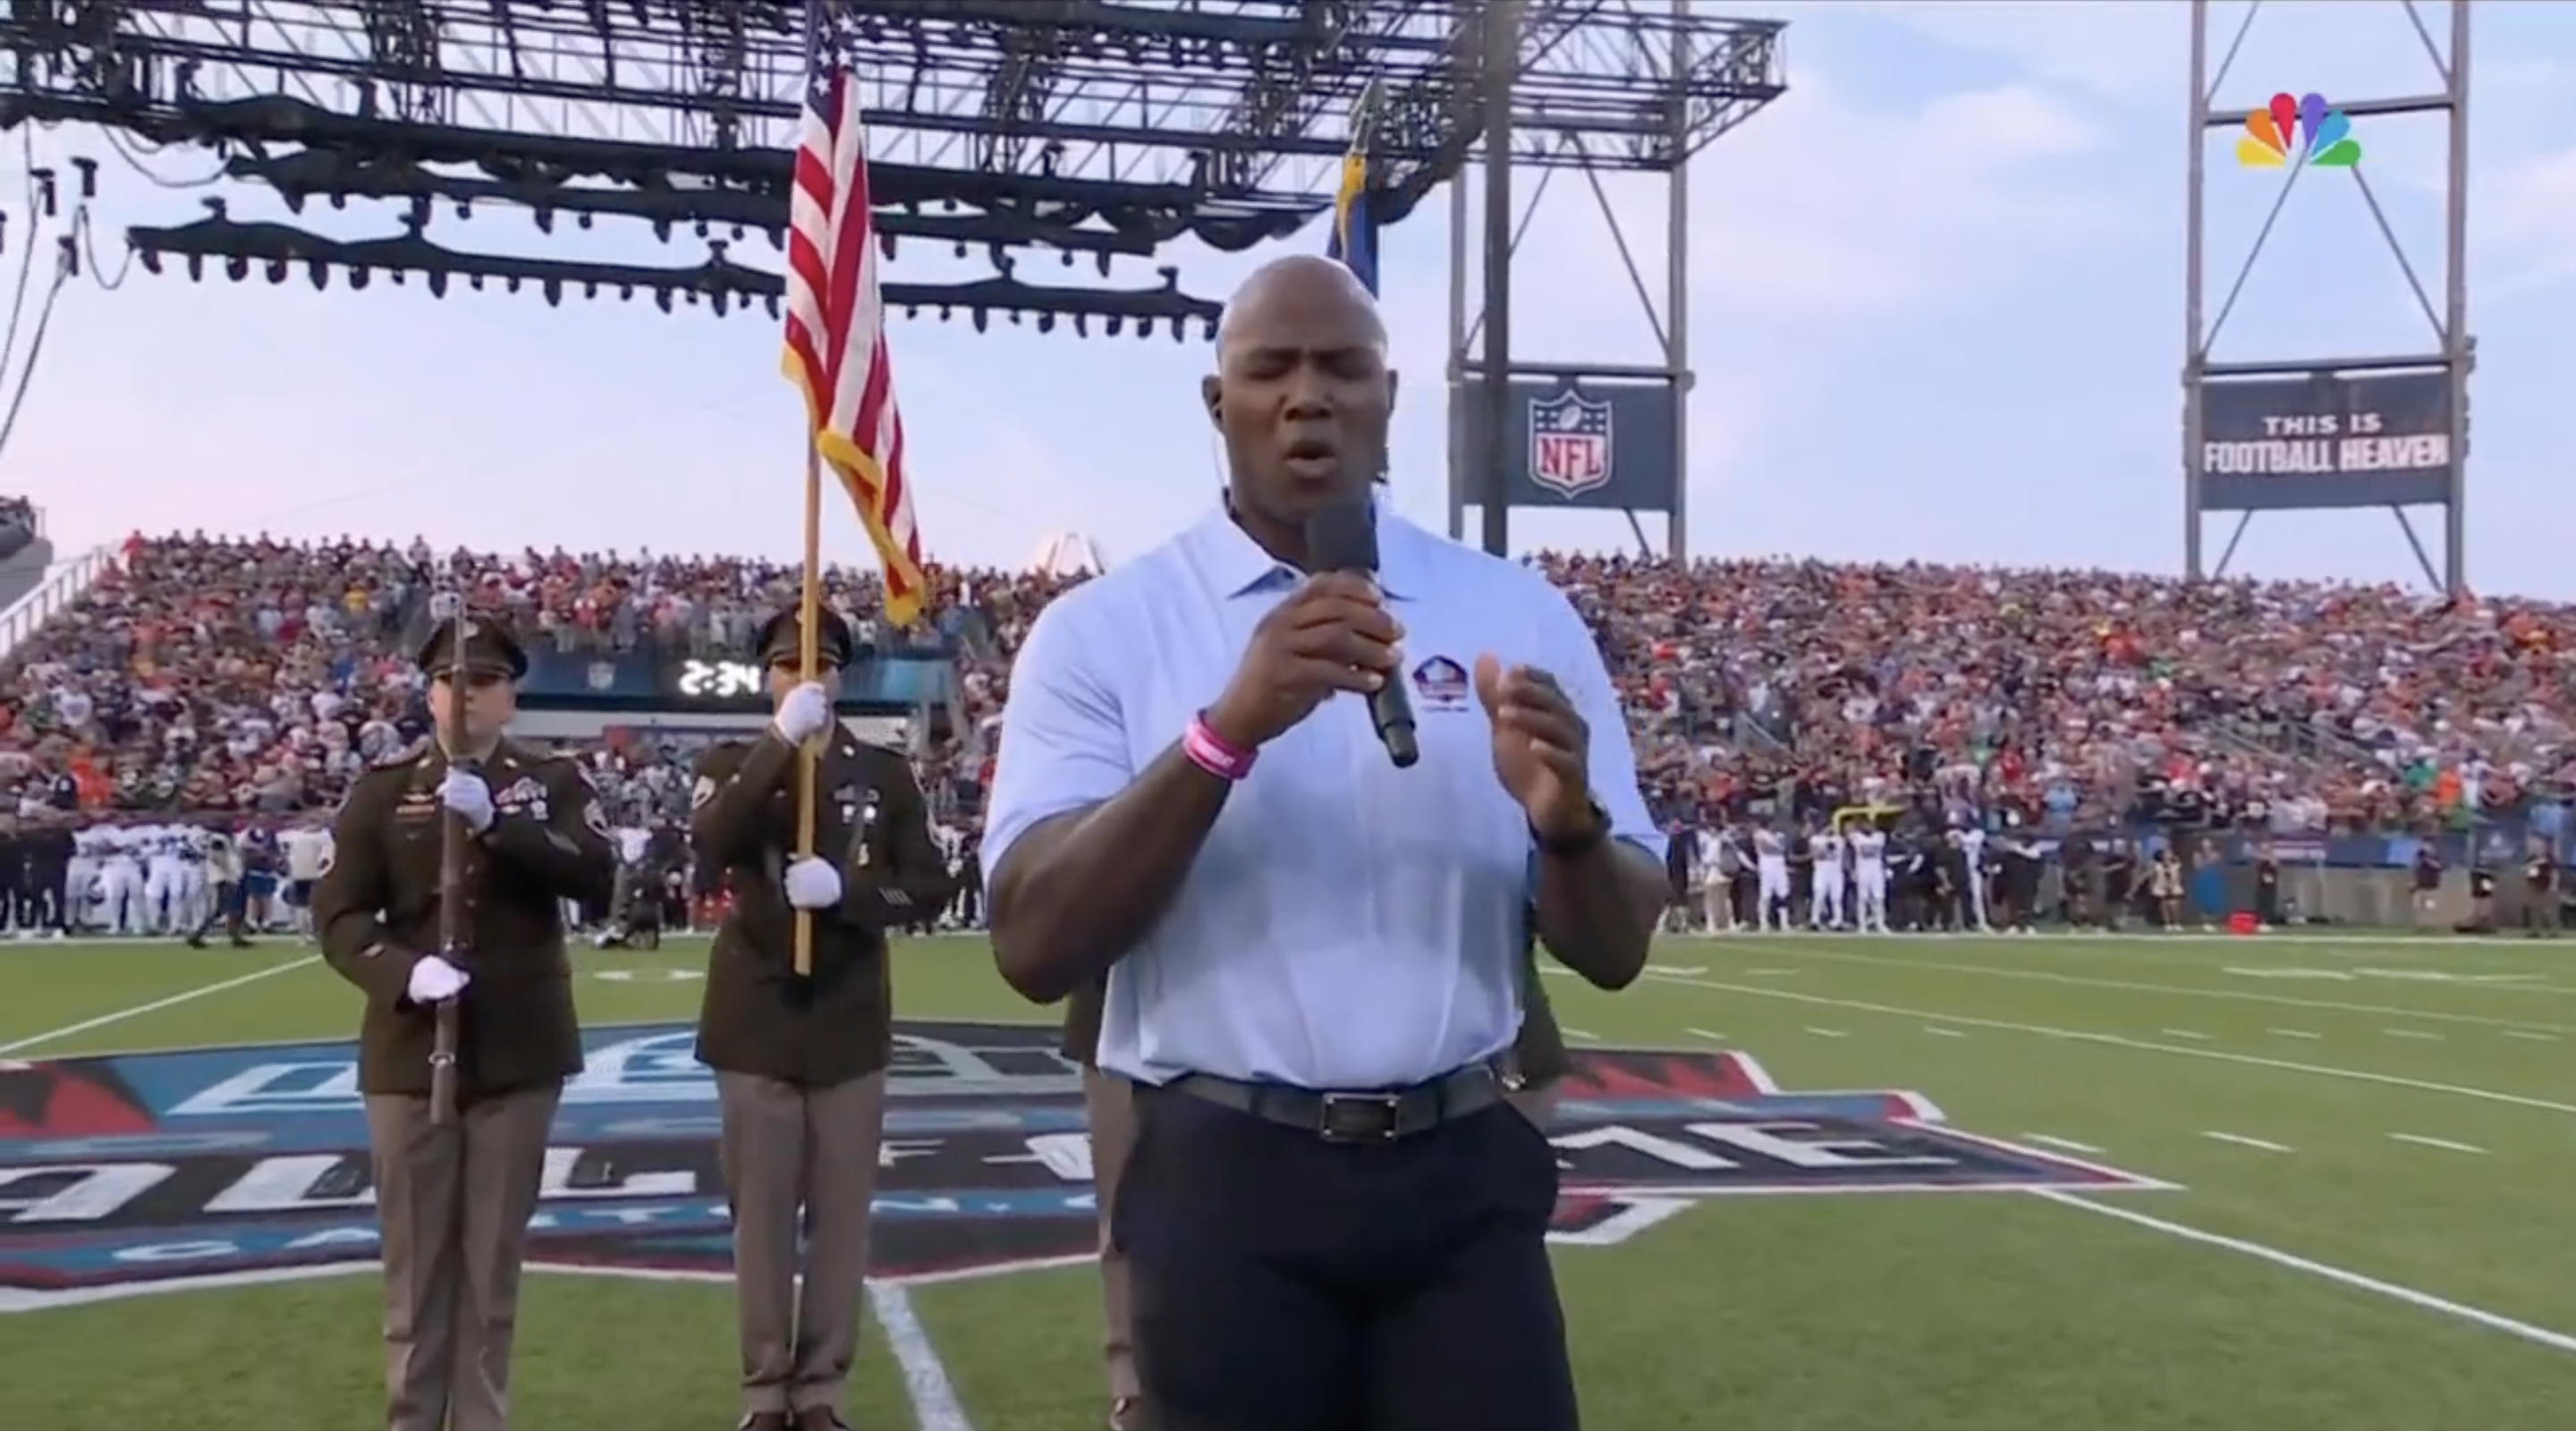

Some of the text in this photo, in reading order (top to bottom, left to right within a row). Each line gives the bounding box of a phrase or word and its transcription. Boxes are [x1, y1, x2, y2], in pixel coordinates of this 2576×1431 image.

[2263, 412, 2383, 435] THIS IS
[1538, 436, 1601, 480] NFL
[2204, 434, 2451, 473] FOOTBALL HEAVEN
[678, 658, 761, 698] 2:34
